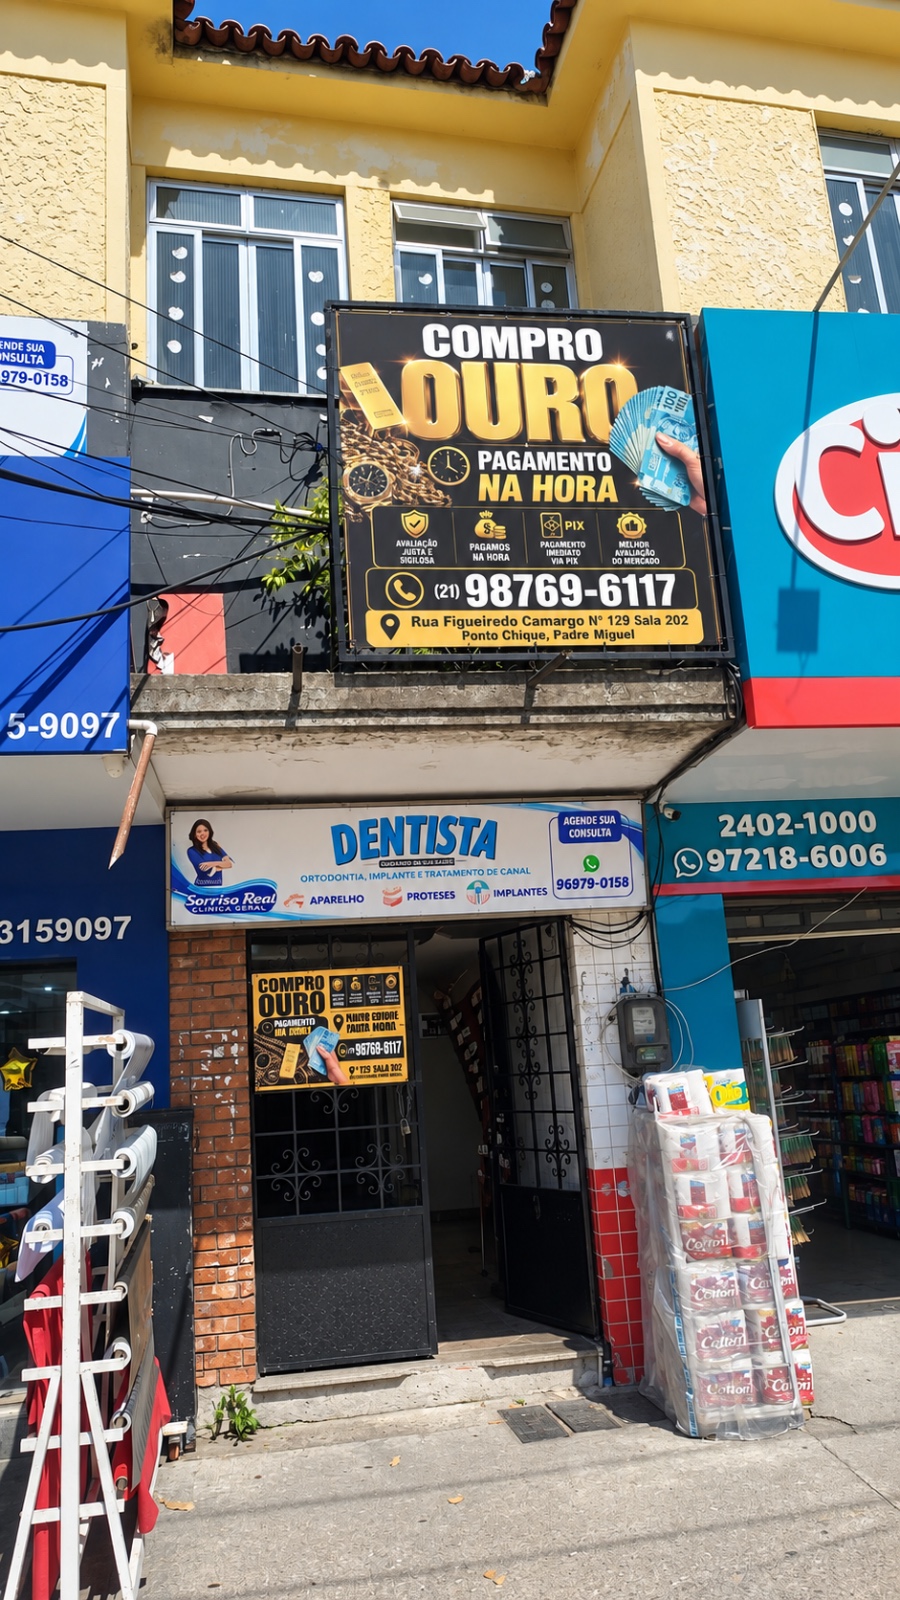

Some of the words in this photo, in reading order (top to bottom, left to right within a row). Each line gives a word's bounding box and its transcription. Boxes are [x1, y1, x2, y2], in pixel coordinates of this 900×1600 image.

[26, 343, 45, 353] SUA
[421, 323, 604, 362] COMPRO
[0, 352, 44, 365] NSULTA
[1, 370, 69, 387] 979-0158
[401, 360, 639, 443] OURO
[478, 450, 612, 472] PAGAMENTO
[478, 473, 523, 502] NA
[532, 474, 619, 503] HORA
[564, 520, 585, 531] PIX
[428, 548, 433, 556] E
[469, 543, 511, 552] PAGAMOS
[472, 553, 484, 562] NA
[487, 553, 510, 562] HORA
[551, 557, 564, 565] VIA
[566, 557, 579, 565] PIX
[612, 557, 622, 565] DO
[624, 557, 660, 565] MERCADO
[434, 584, 460, 601] (21)
[465, 573, 676, 608] 98769-6117
[411, 616, 439, 628] Rua
[443, 615, 518, 630] Figueiredo
[522, 615, 585, 629] Camargo
[607, 615, 631, 626] 129
[634, 615, 662, 626] Sala
[665, 615, 689, 626] 202
[462, 631, 499, 641] Ponto
[502, 630, 550, 642] Chique,
[553, 630, 590, 640] Padre
[594, 629, 635, 642] Miguel
[563, 817, 597, 826] AGENDE
[599, 816, 616, 825] SUA
[718, 810, 877, 838] 2402-1000
[331, 815, 498, 866] DENTISTA
[569, 829, 612, 838] CONSULTA
[706, 843, 888, 873] 97218-6006
[300, 873, 367, 883] ORTODONTIA,
[369, 871, 415, 881] IMPLANTE
[418, 870, 423, 879] E
[425, 868, 484, 878] TRATAMENTO
[487, 868, 498, 876] DE
[500, 867, 531, 875] CANAL
[557, 876, 629, 890] 96979-0158
[407, 890, 456, 901] PROTESES
[493, 887, 548, 897] IMPLANTES
[186, 894, 239, 907] Sorriso
[243, 892, 277, 905] Real
[309, 894, 364, 905] APARELHO
[258, 975, 325, 993] COMPRO
[258, 991, 325, 1017] OURO
